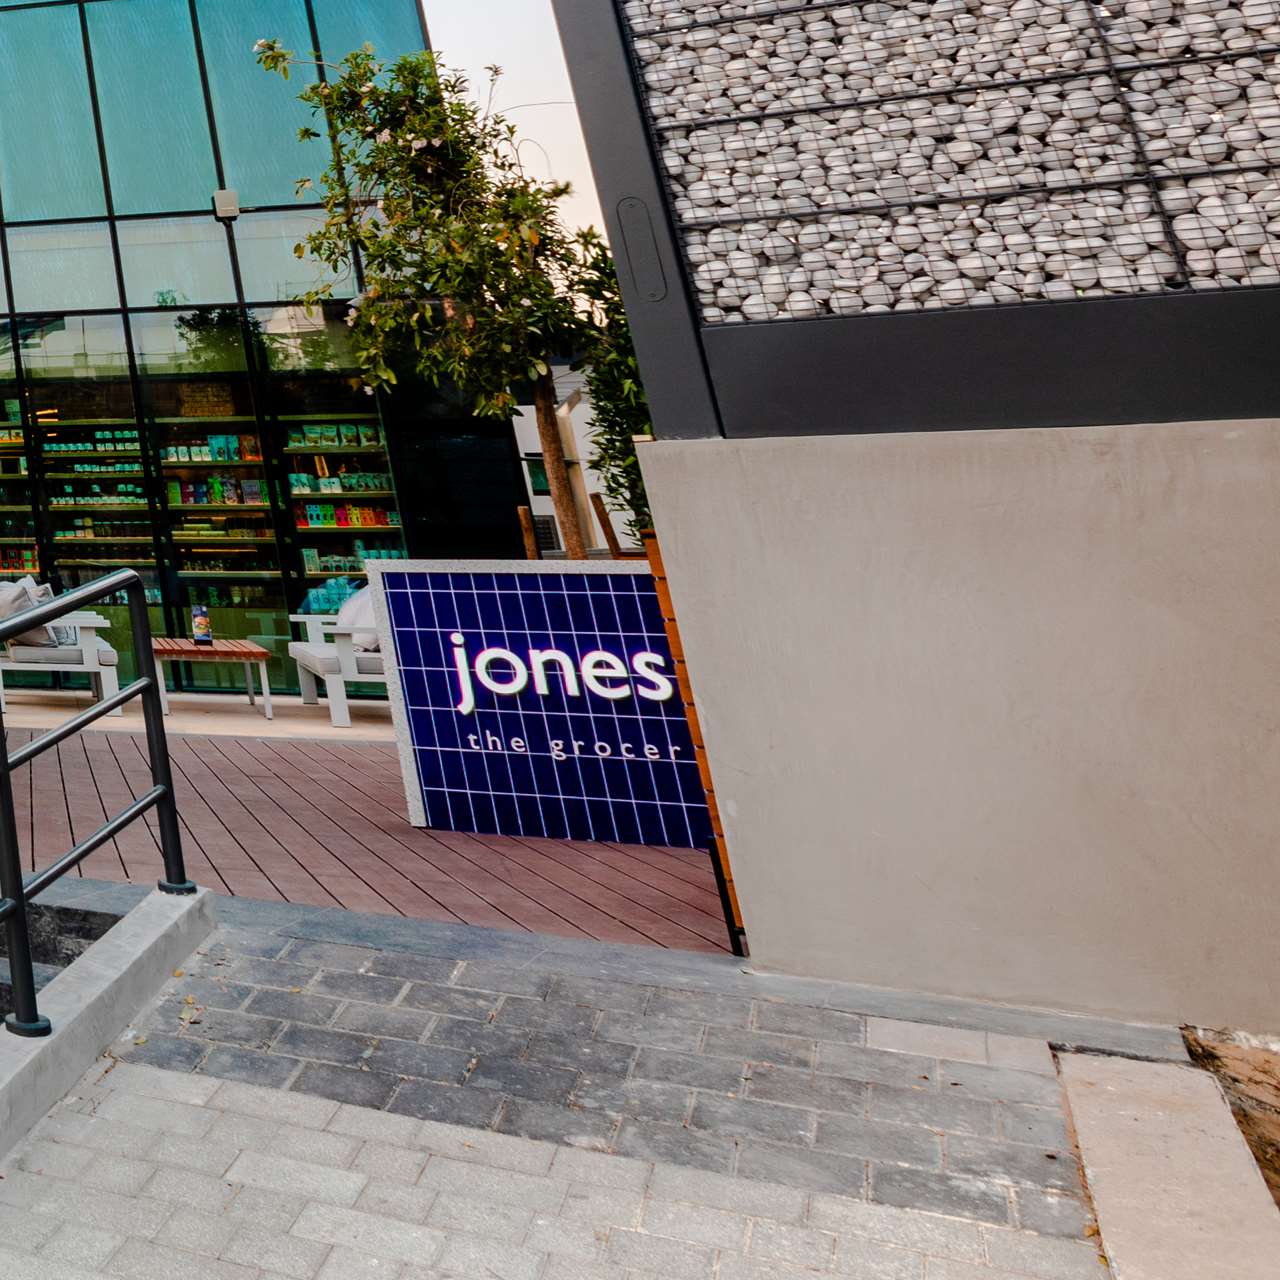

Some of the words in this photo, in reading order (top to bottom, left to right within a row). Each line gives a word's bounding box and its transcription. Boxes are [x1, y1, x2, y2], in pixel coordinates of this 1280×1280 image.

[449, 632, 674, 716] jones
[466, 729, 527, 753] the
[549, 738, 682, 761] grocer
